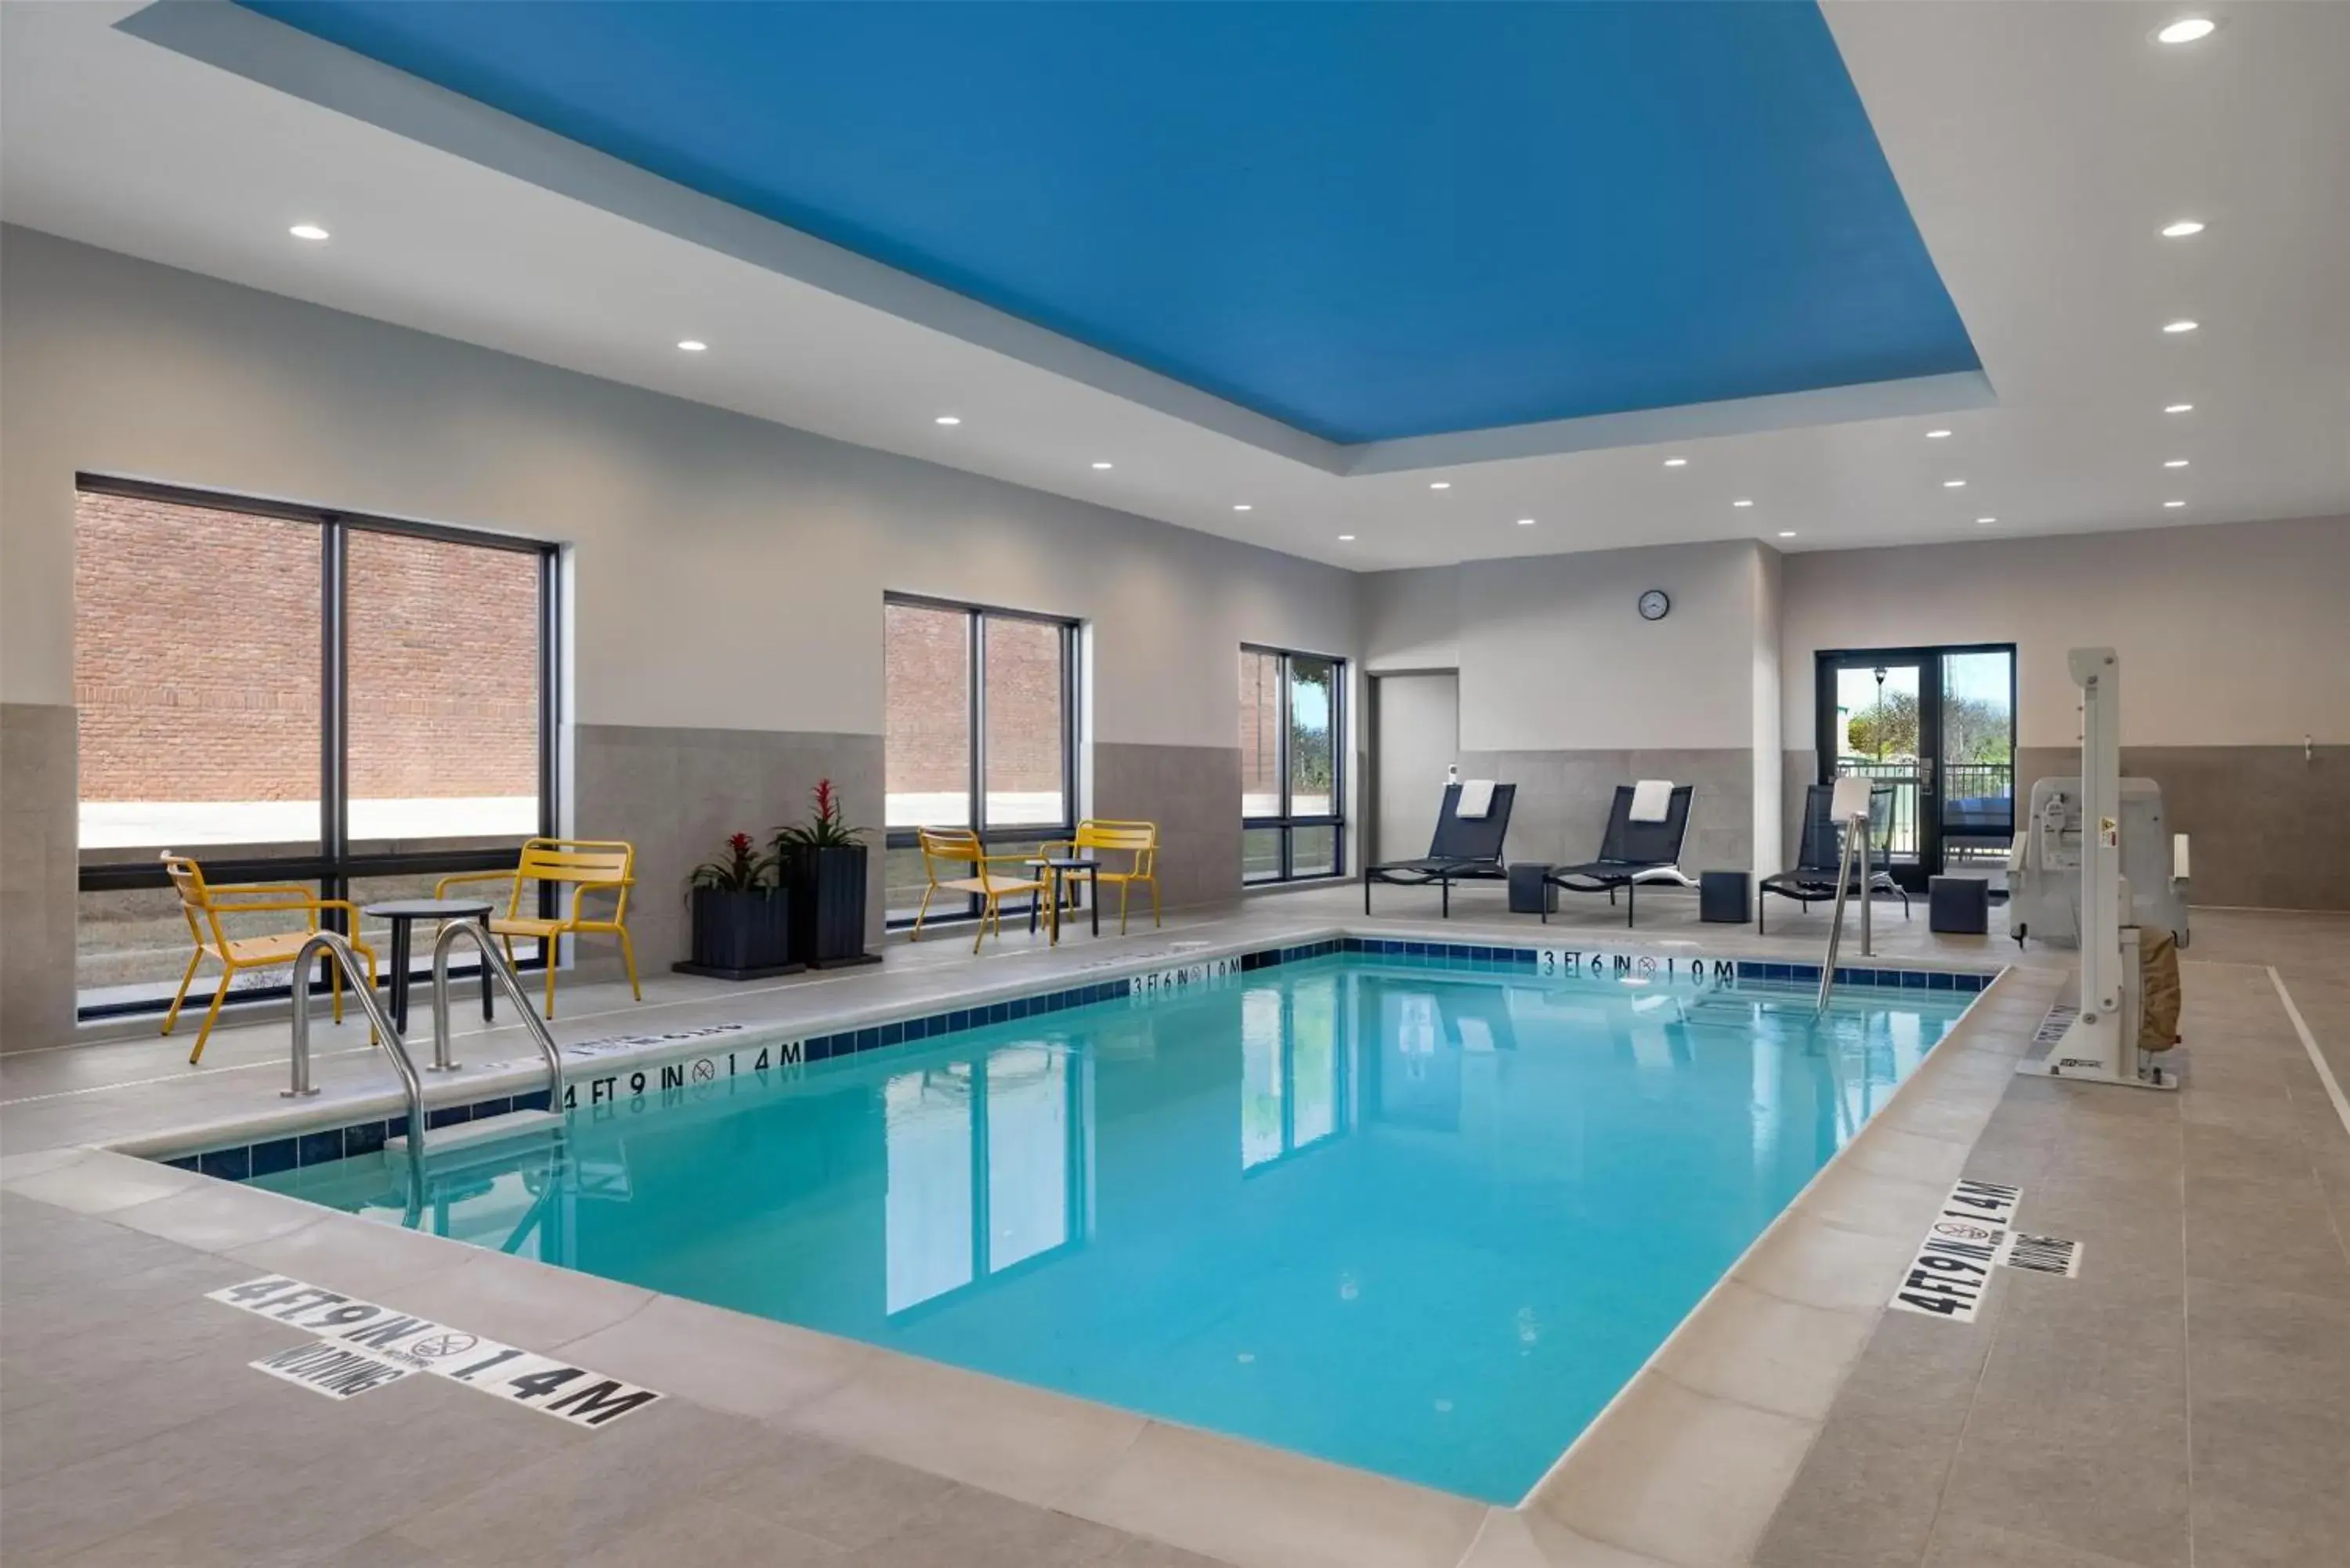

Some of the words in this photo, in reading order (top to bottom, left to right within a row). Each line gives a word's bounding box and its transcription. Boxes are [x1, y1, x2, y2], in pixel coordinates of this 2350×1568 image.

[1148, 974, 1159, 990] FT
[1164, 971, 1171, 988] 6
[1544, 950, 1554, 967] 3
[1564, 952, 1581, 967] FT
[1591, 954, 1602, 973] 6
[1614, 954, 1631, 971] IN
[1714, 959, 1734, 976] M
[591, 1076, 617, 1104] FT
[630, 1071, 645, 1095] 9
[661, 1064, 683, 1090] IN
[780, 1041, 801, 1065] M
[285, 1351, 405, 1396] DIVING
